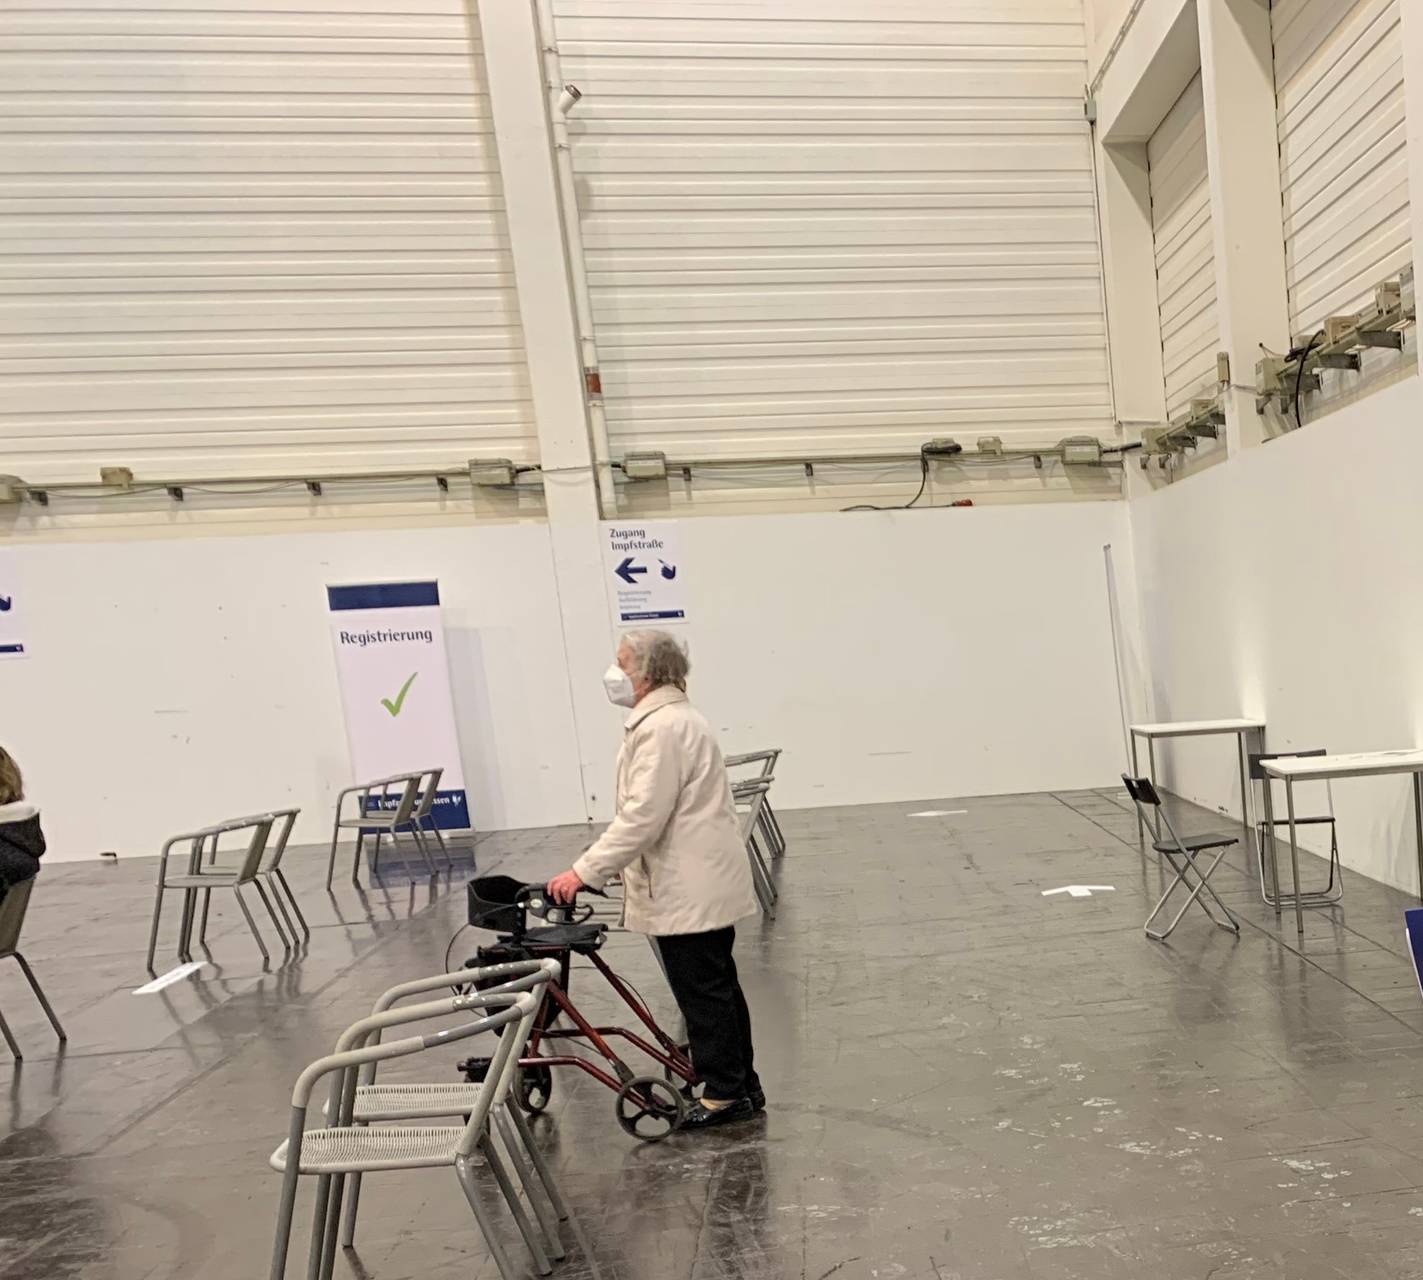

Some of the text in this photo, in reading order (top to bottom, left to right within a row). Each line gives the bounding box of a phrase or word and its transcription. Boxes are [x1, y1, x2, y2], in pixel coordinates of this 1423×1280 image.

[609, 528, 646, 539] Zugang
[611, 539, 664, 552] Impfstraße
[340, 628, 433, 648] Registrierung
